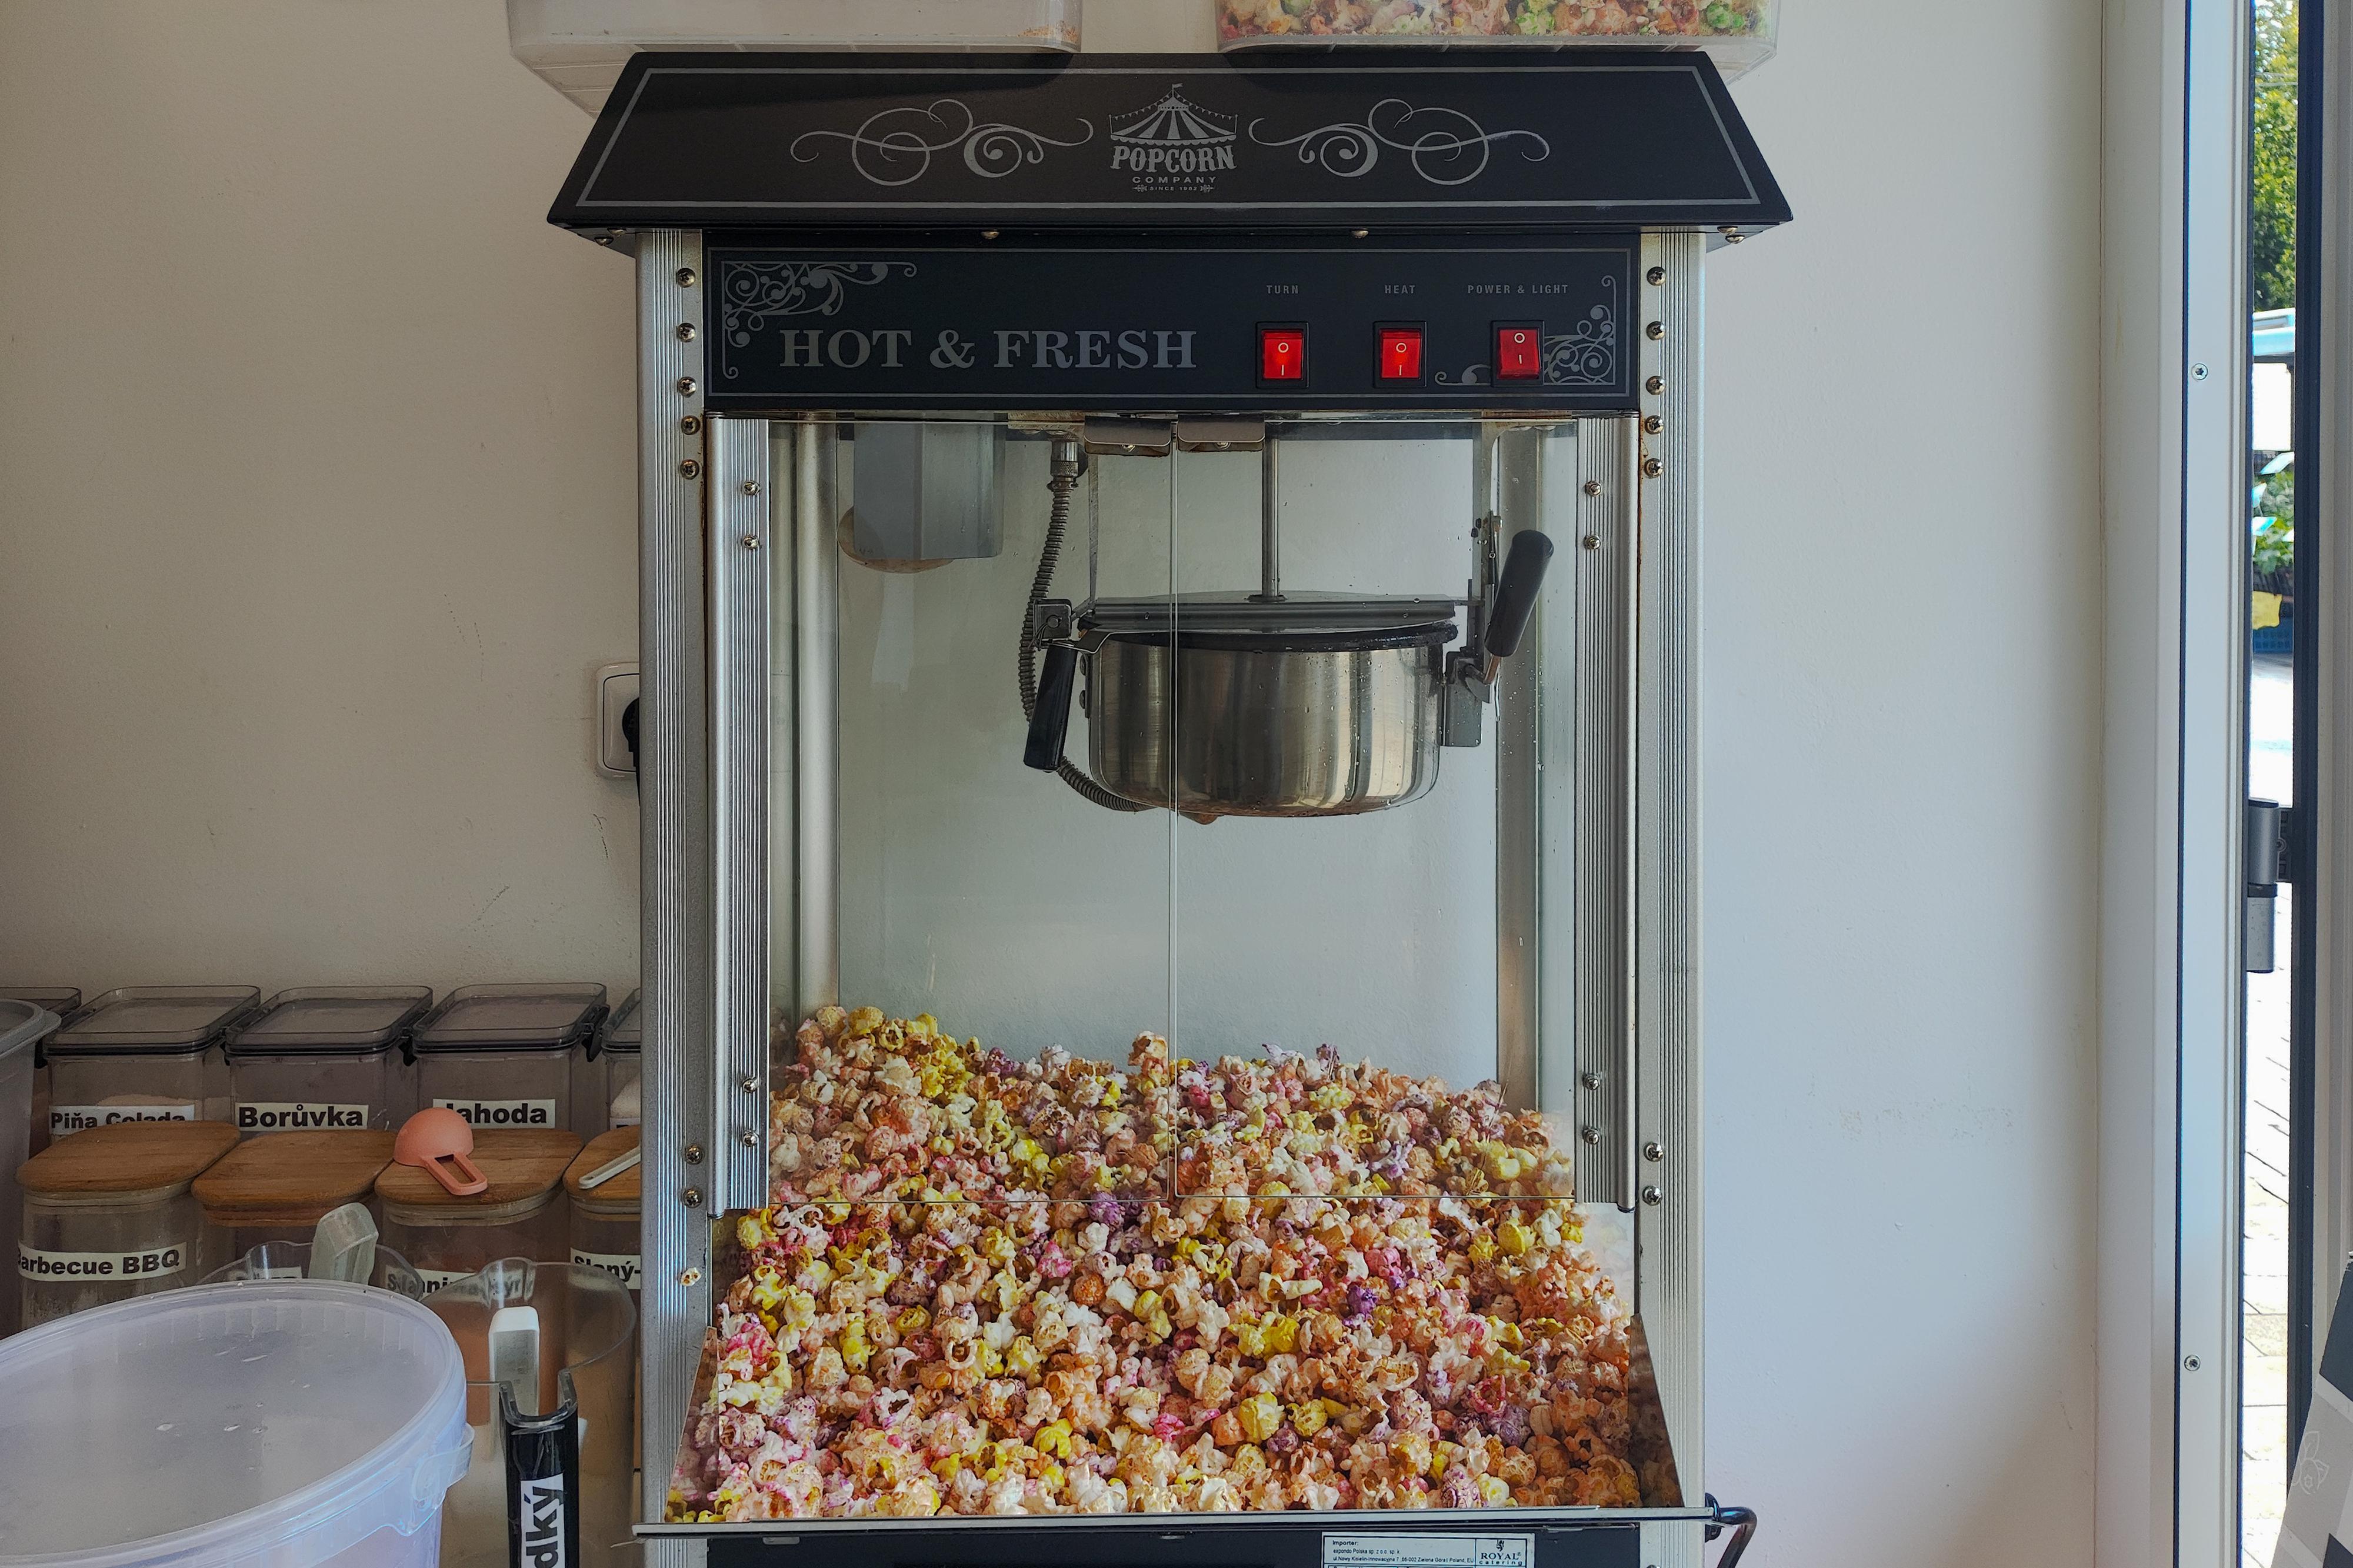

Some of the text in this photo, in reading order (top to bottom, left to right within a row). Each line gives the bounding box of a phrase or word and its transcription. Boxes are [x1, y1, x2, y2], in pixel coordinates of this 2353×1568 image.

[1110, 145, 1237, 173] POPCORN
[1267, 285, 1299, 294] TURN
[1384, 285, 1416, 294] HEAT
[1468, 284, 1569, 294] POWER & LIGHT
[779, 329, 1197, 369] HOT & FRESH
[239, 1104, 363, 1127] Borůvka
[122, 1249, 179, 1275] BBQ
